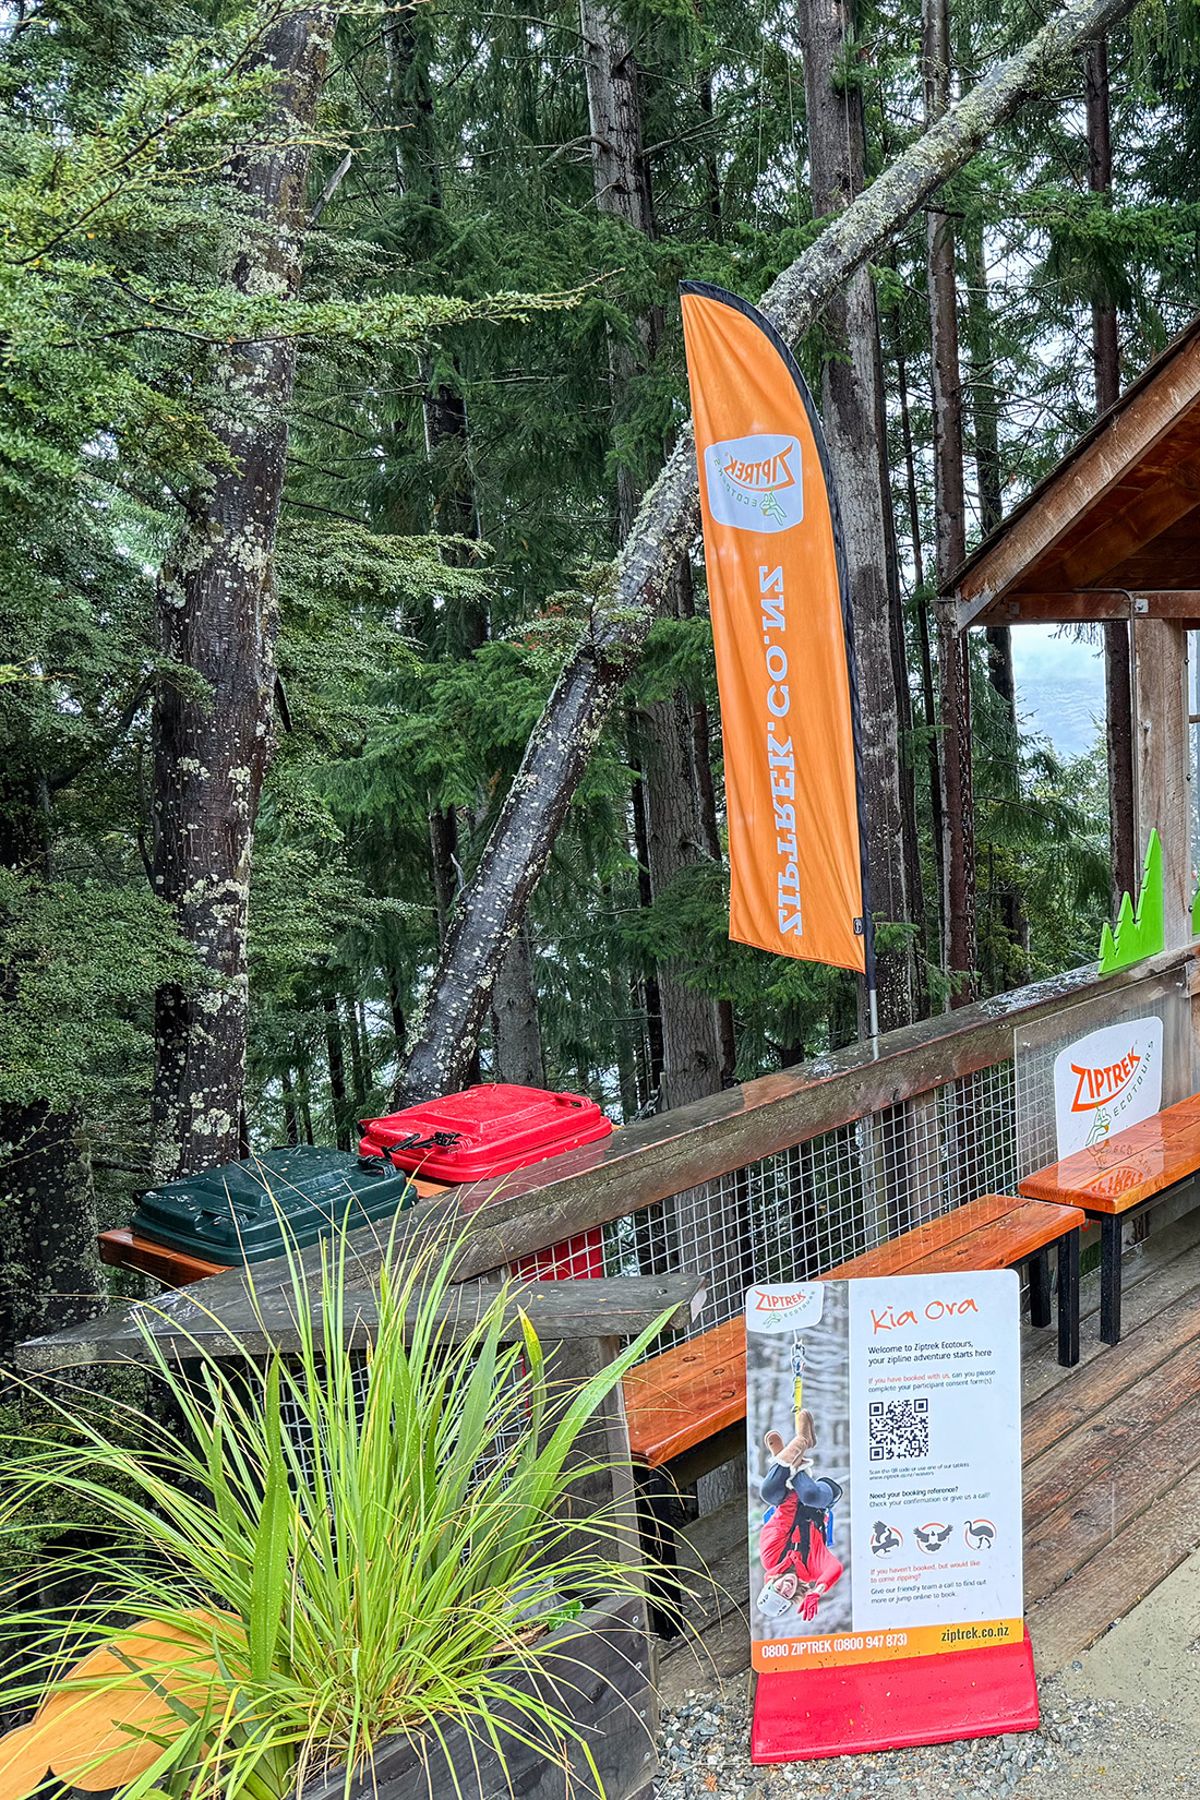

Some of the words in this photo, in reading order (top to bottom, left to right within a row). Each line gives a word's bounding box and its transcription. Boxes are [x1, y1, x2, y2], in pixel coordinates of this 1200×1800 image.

[1071, 1046, 1141, 1112] ZIPTREK
[1112, 1041, 1154, 1116] ECOTOURS
[755, 1290, 806, 1311] ZIPTREK
[871, 1306, 918, 1334] Kia
[925, 1299, 978, 1320] Ora
[868, 1346, 902, 1354] Welcome
[915, 1342, 940, 1352] Ziptrek
[941, 1341, 973, 1349] Ecotours,
[868, 1358, 884, 1367] your
[888, 1355, 911, 1365] zipline
[914, 1353, 950, 1361] adventure
[868, 1385, 896, 1393] complete
[898, 1384, 911, 1392] your
[913, 1382, 944, 1390] participant
[887, 1492, 900, 1500] your
[927, 1486, 958, 1494] reference?
[889, 1500, 901, 1508] your
[897, 1585, 920, 1593] friendly
[896, 1596, 912, 1604] jump
[762, 1644, 789, 1658] 0800
[791, 1640, 831, 1655] ZIPTREK
[834, 1636, 863, 1652] (0800
[866, 1635, 884, 1649] 947
[886, 1633, 907, 1647] 873)
[941, 1626, 1009, 1642] ziptrek.co.nz
